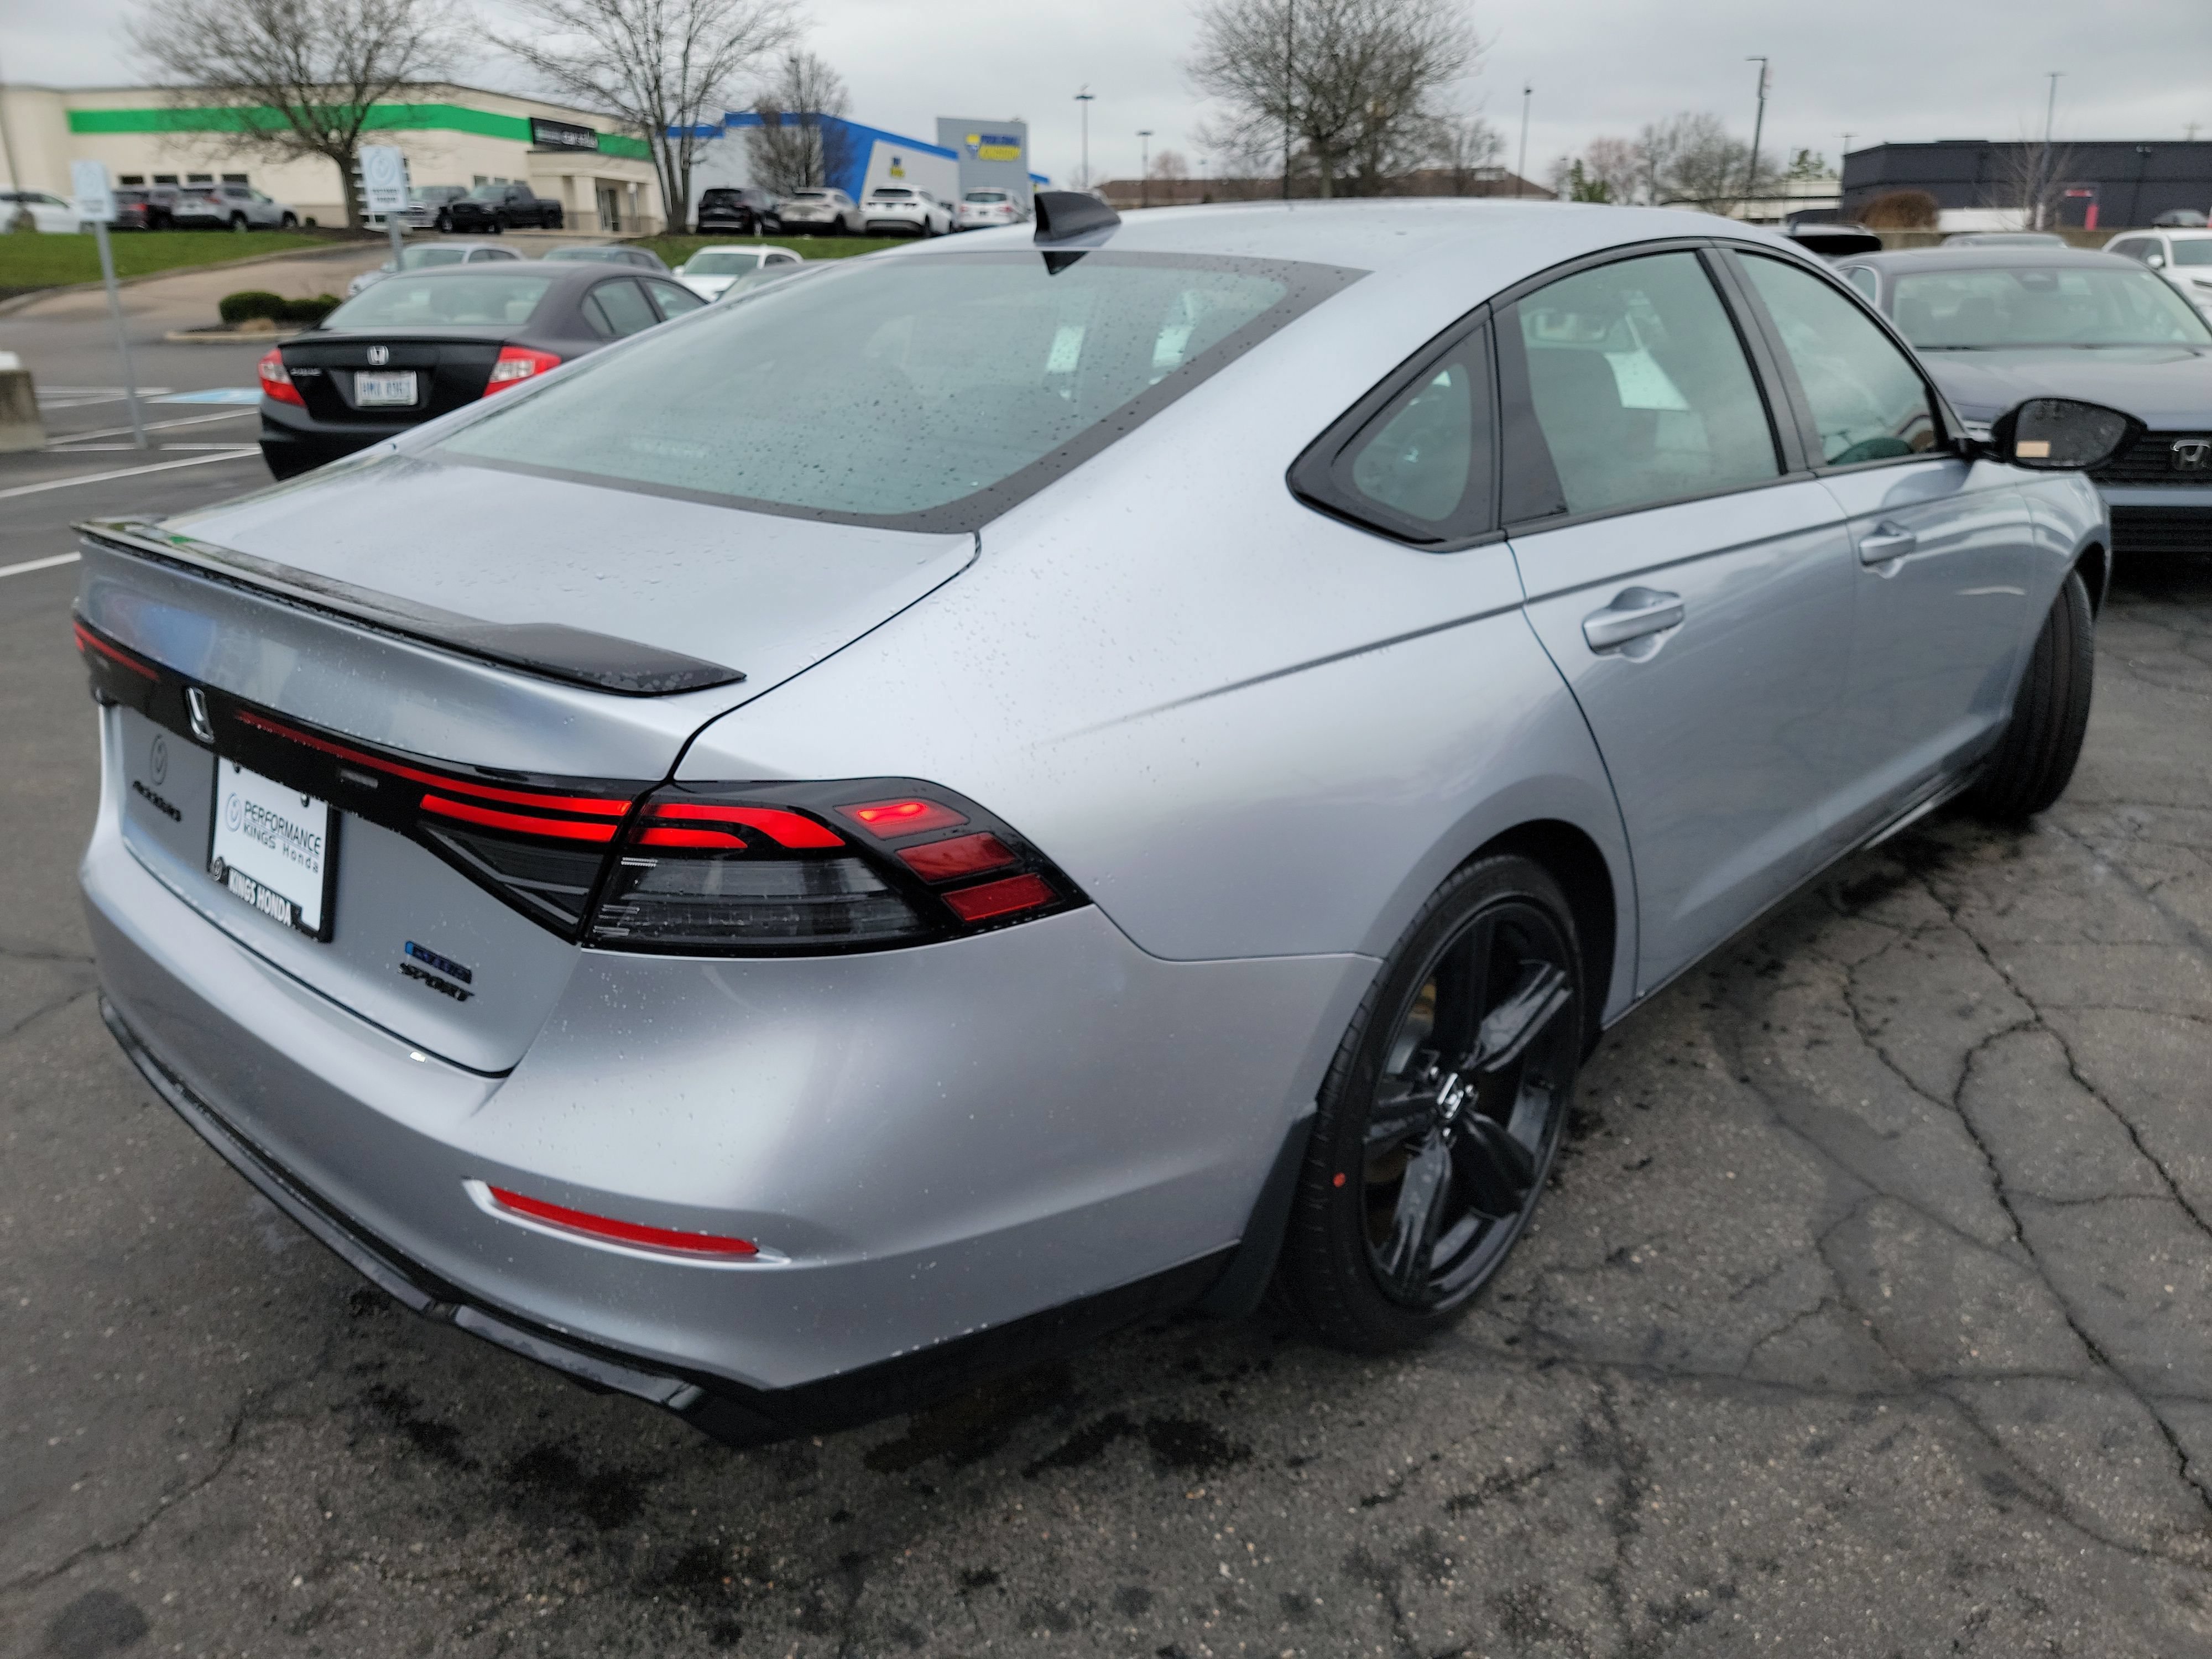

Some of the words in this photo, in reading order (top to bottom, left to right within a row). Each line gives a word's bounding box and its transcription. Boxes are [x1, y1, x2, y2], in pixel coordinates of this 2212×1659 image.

[244, 800, 321, 855] PERFORMANCE
[244, 823, 275, 849] KINGS
[283, 842, 319, 873] Honda
[228, 869, 257, 905] KINGS
[257, 885, 292, 927] HONDA
